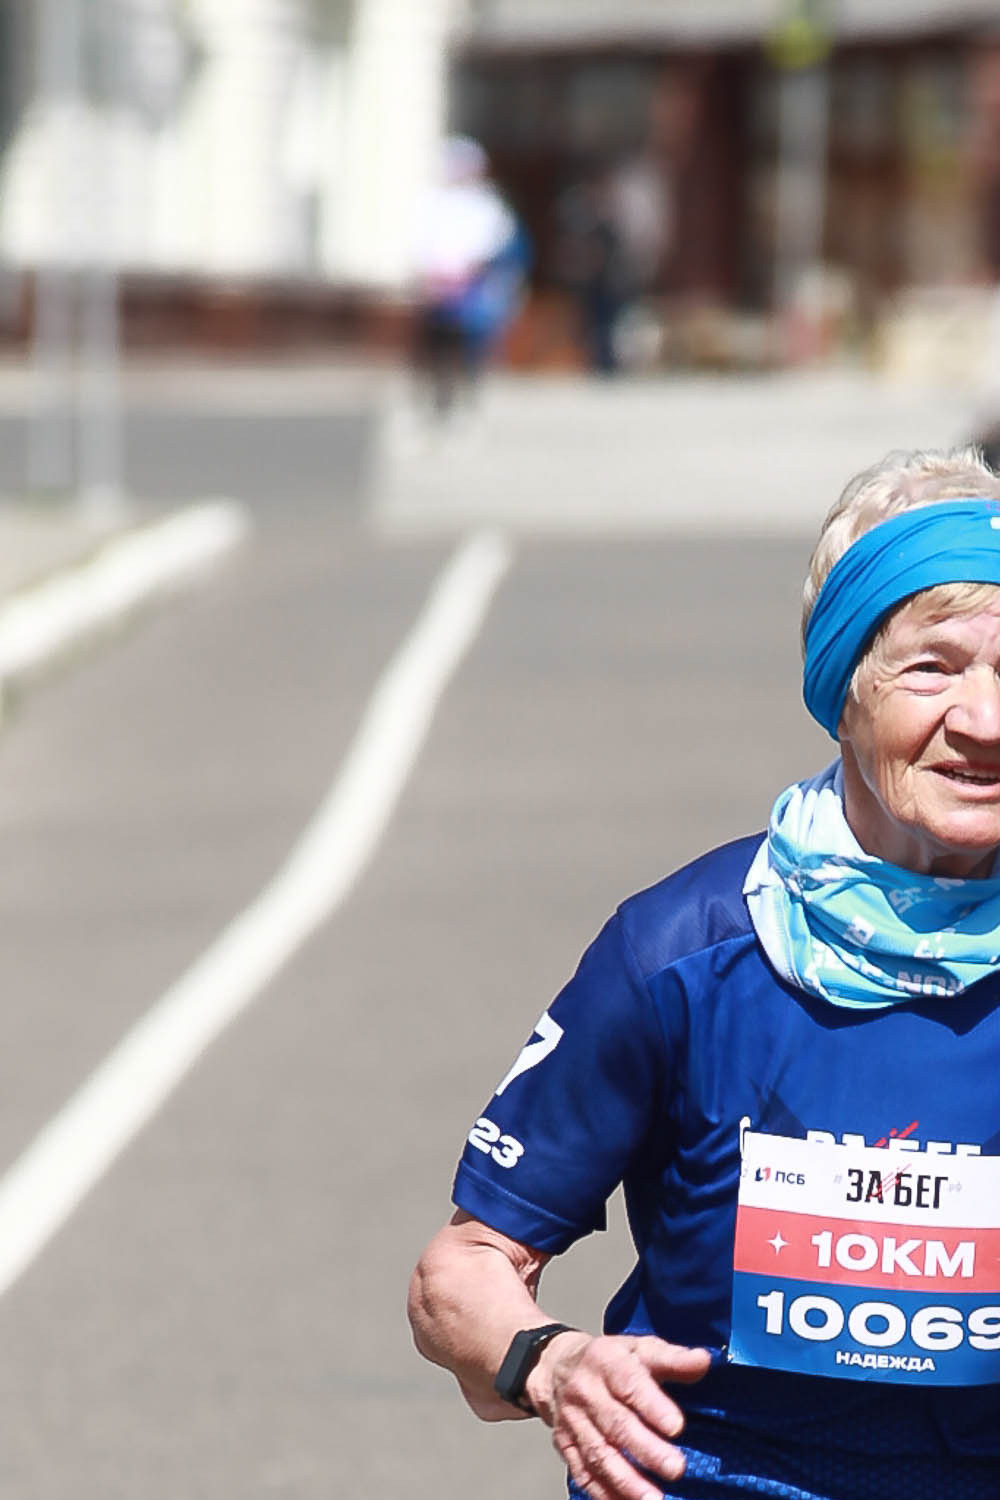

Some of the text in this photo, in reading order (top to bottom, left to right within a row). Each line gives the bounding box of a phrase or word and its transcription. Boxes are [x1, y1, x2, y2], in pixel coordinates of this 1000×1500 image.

[468, 1117, 525, 1169] 23
[774, 1170, 806, 1185] ПСБ
[835, 1350, 936, 1373] НАДЕЖДА
